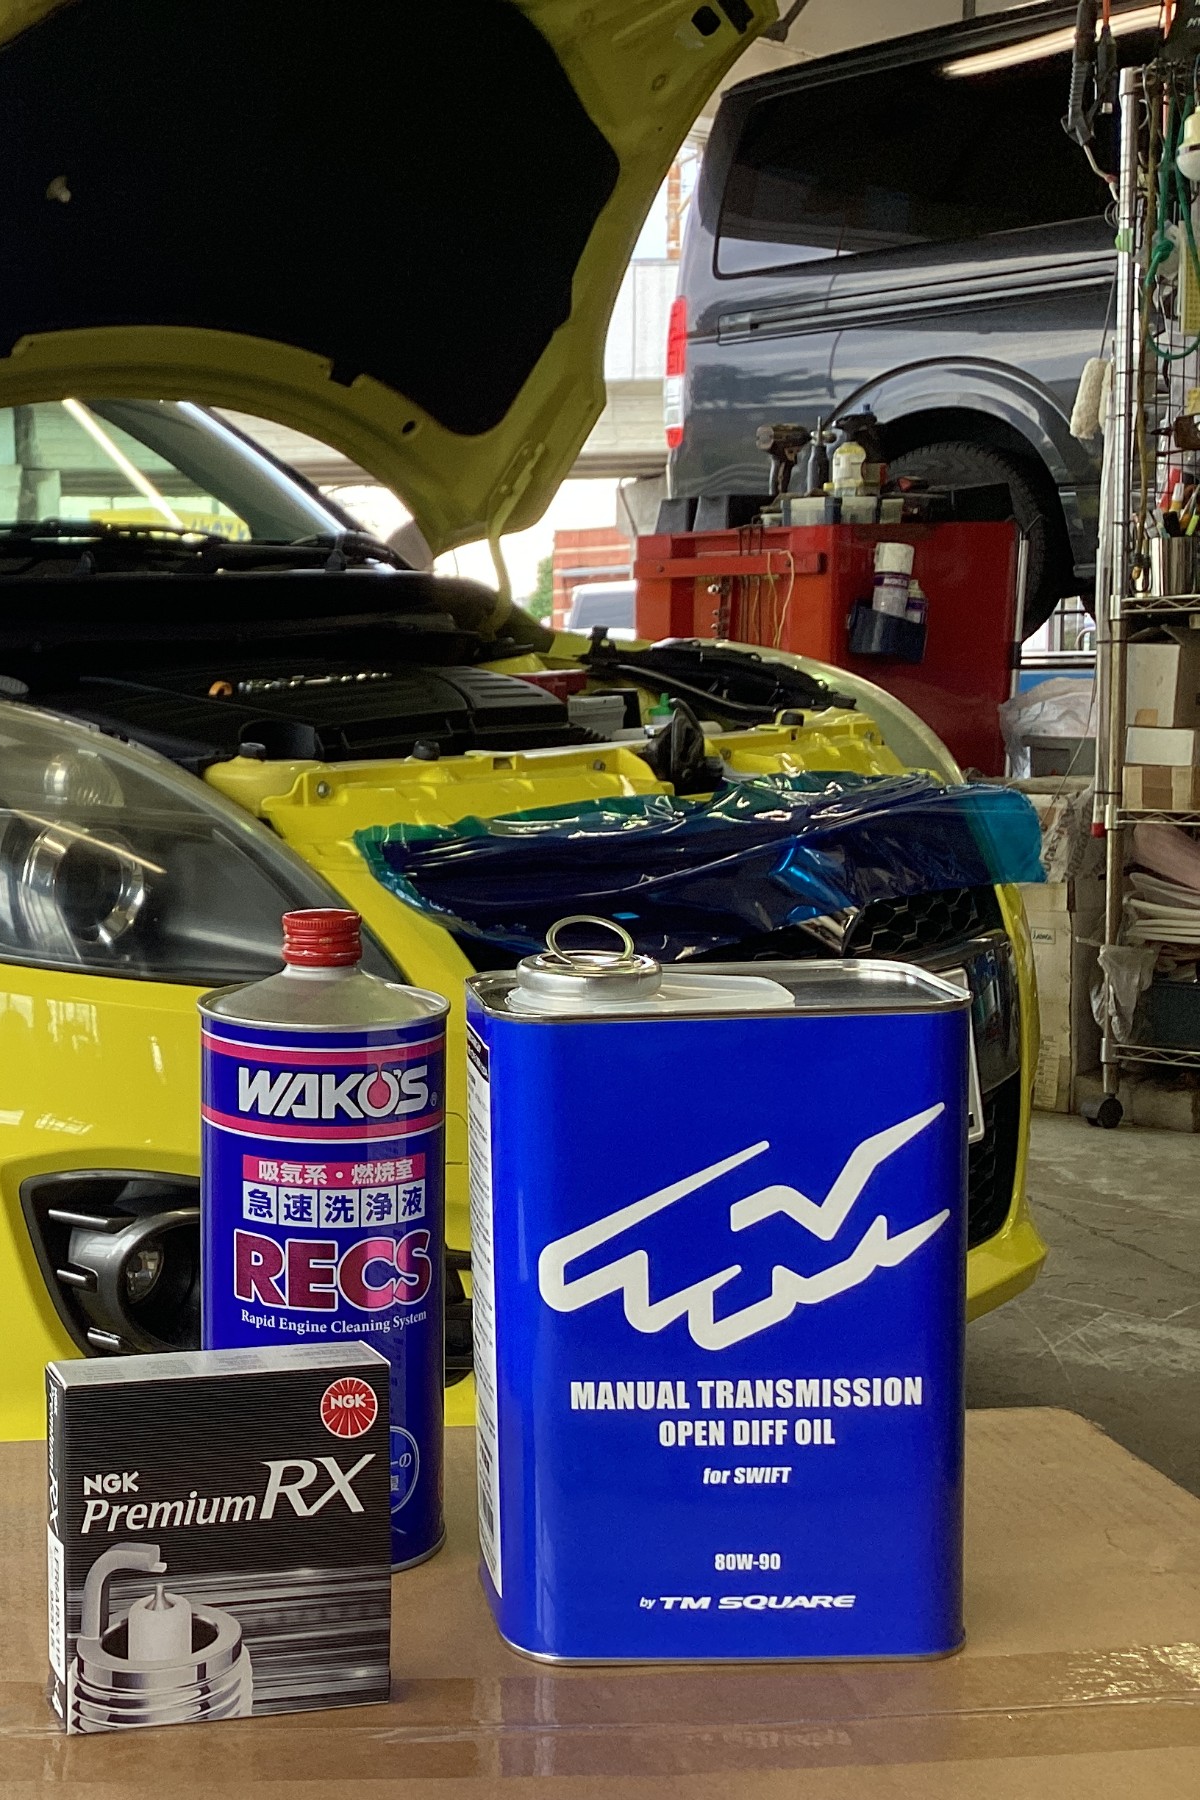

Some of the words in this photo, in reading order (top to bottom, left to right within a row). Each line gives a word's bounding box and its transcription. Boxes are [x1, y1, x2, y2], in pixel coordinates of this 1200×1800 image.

[238, 1064, 429, 1119] WAKO'S
[258, 1158, 414, 1185] 吸気系・燃焼室
[247, 1186, 423, 1224] 急速洗浄液
[233, 1228, 432, 1312] RECS
[240, 1308, 276, 1329] Rapid
[278, 1316, 327, 1335] Engine
[330, 1314, 391, 1334] Cleaning
[392, 1309, 427, 1331] System
[330, 1392, 367, 1410] NGK
[570, 1380, 690, 1410] MANUAL
[697, 1376, 923, 1409] TRANSMISSION
[658, 1420, 726, 1447] OPEN
[732, 1419, 788, 1446] DIFF
[794, 1418, 836, 1446] OIL
[83, 1471, 140, 1495] NGK
[702, 1467, 731, 1486] for
[734, 1466, 792, 1485] SWIFT
[80, 1491, 257, 1534] Premium
[259, 1453, 377, 1519] RX
[714, 1552, 781, 1571] 80W-90
[639, 1596, 656, 1611] by
[661, 1595, 712, 1610] TM
[718, 1594, 856, 1611] SQUARE
